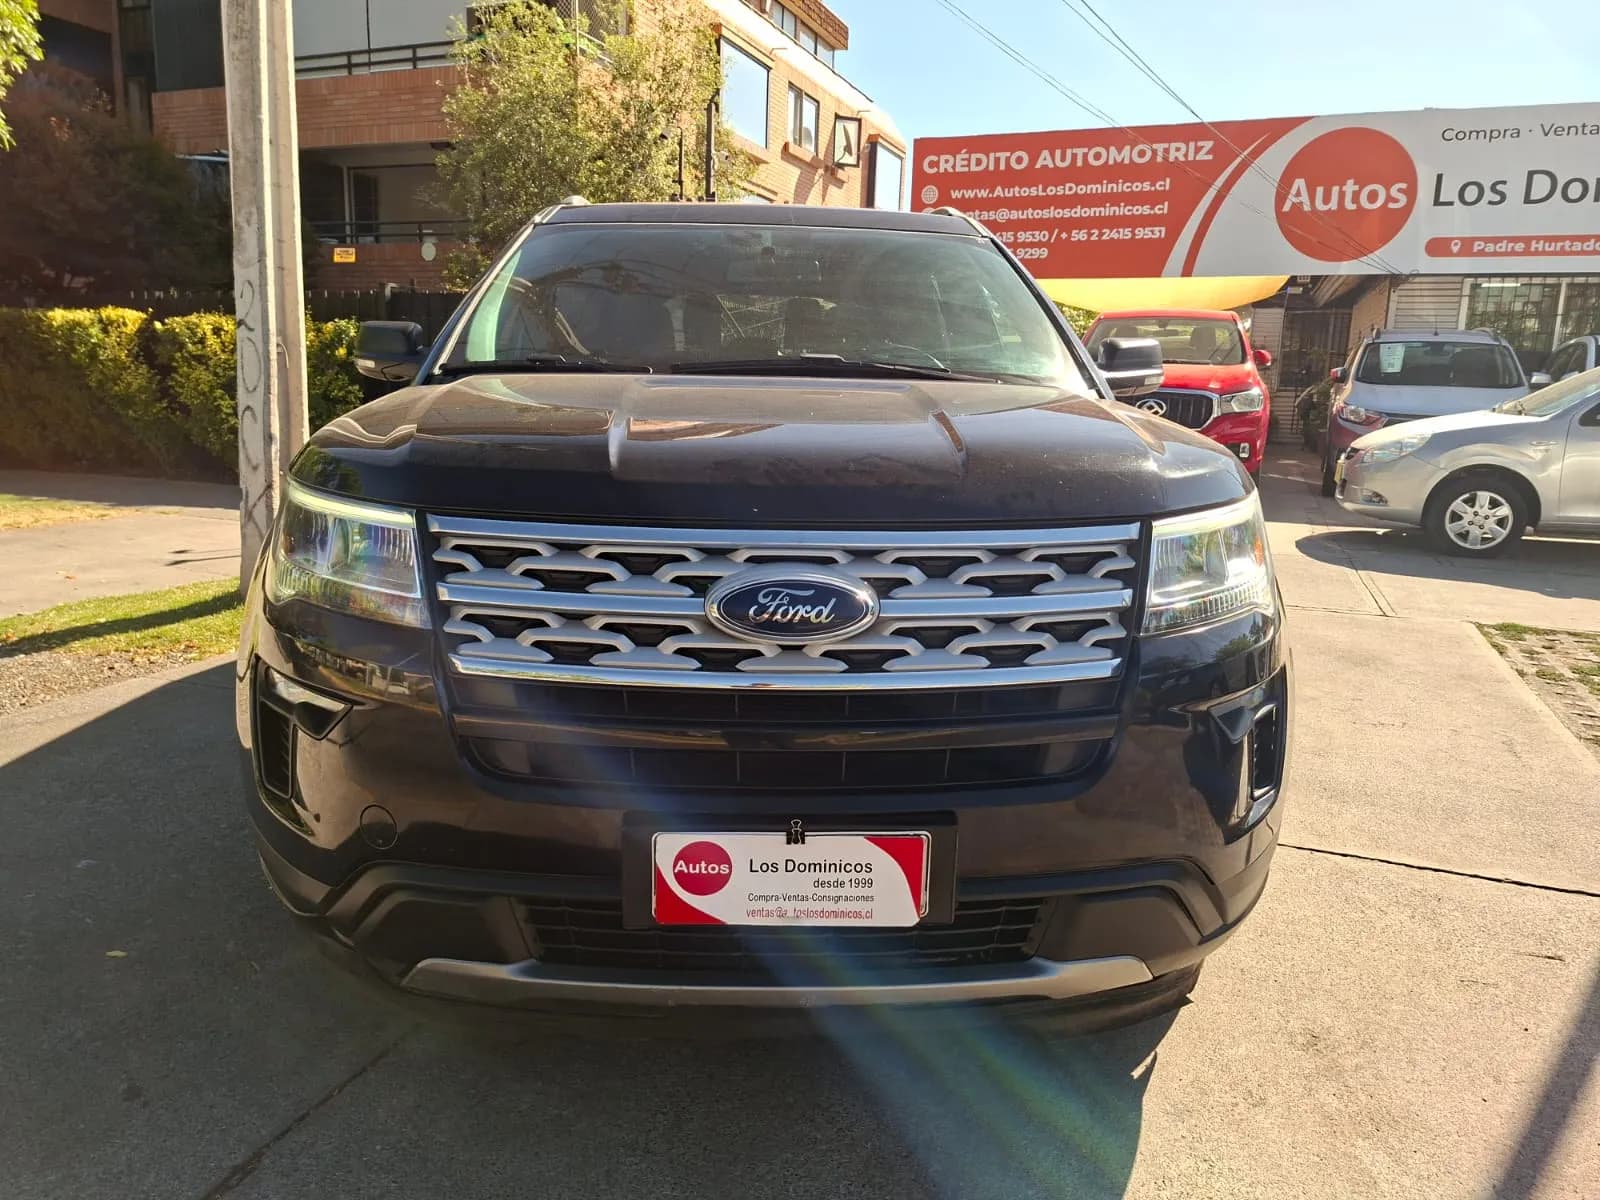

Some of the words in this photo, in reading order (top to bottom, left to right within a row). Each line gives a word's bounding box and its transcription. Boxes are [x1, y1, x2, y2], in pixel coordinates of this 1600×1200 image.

[1441, 127, 1522, 144] Compra
[922, 148, 1029, 174] CRÉDITO
[1035, 140, 1215, 170] AUTOMOTRIZ
[950, 178, 1171, 200] www.AutosLosDominicos.cl
[1281, 177, 1409, 213] Autos
[1432, 172, 1508, 207] Los
[966, 201, 1169, 222] ntas@autoslosdominicos.cl
[1016, 230, 1049, 243] 9530
[1071, 229, 1087, 242] 56
[1090, 229, 1099, 241] 2
[1101, 228, 1132, 241] 2415
[1134, 226, 1166, 239] 9531
[1016, 247, 1049, 260] 9299
[1472, 239, 1526, 253] Padre
[748, 587, 837, 624] Ford
[674, 860, 730, 876] Autos
[749, 859, 779, 874] Los
[784, 858, 874, 874] Dominicos
[813, 877, 845, 889] desde
[848, 878, 874, 889] 1999
